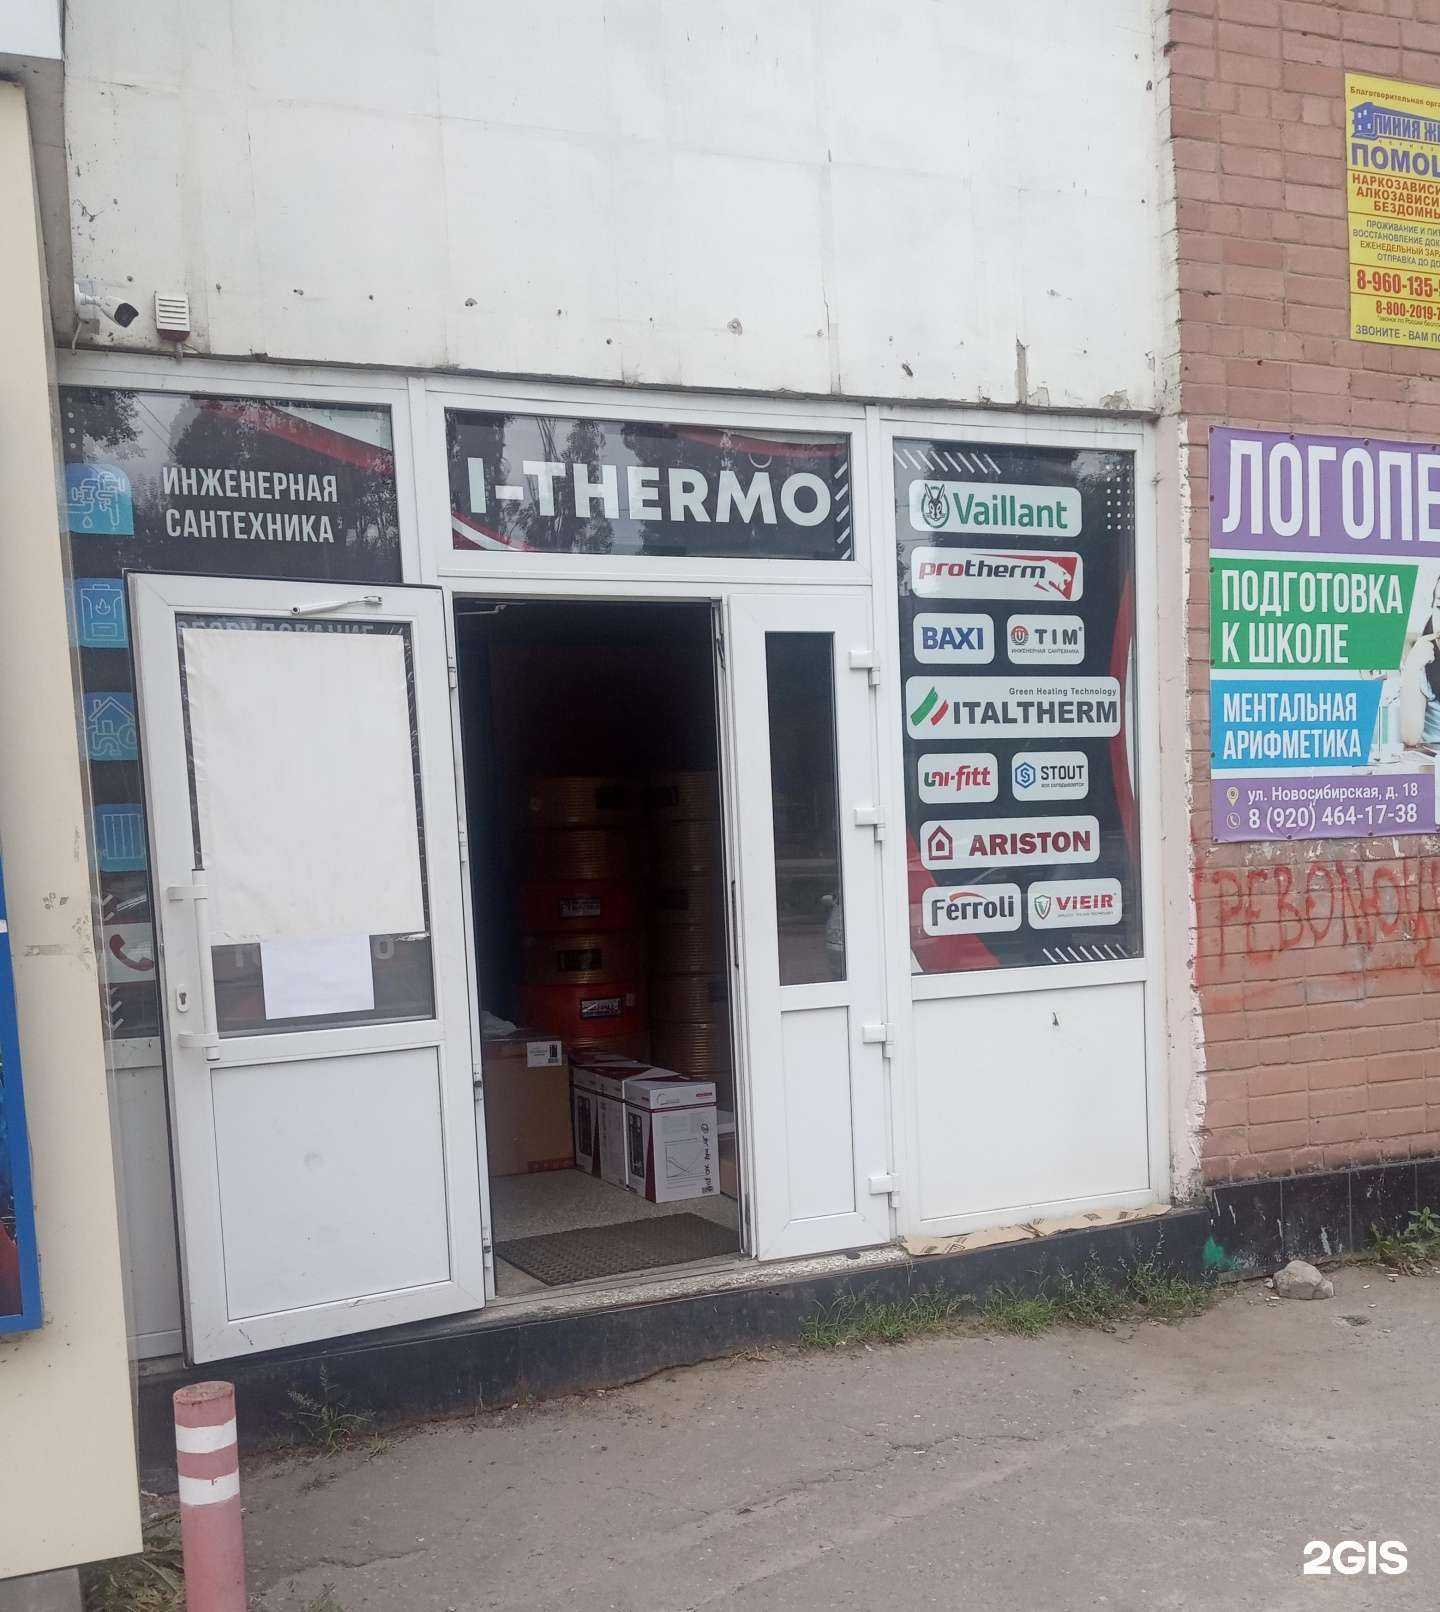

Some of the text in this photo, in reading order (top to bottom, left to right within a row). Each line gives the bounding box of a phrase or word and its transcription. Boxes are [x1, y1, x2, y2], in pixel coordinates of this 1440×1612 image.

[1350, 86, 1424, 105] Благотворительная
[1373, 113, 1421, 140] ЛИНИЯ
[1356, 186, 1440, 208] АЛКОЗАВИСИ
[1352, 228, 1423, 245] ВОССТАНОВЛЕНИЕ
[1366, 219, 1419, 234] ПРОЖИВАНИЕ
[1360, 240, 1424, 256] ЕЖЕНЕДЕЛЬНЫЙ
[1376, 253, 1416, 265] ОТПРАВКА
[1418, 258, 1429, 267] ДО
[1357, 269, 1440, 298] 8-960-135-
[1355, 325, 1401, 339] ЗВОНИТЕ
[1408, 330, 1429, 342] ВАМ
[162, 466, 338, 503] ИНЖЕНЕРНАЯ
[467, 457, 831, 527] I-THERMO
[1222, 439, 1440, 542] ЛОГОПЕ
[952, 492, 1068, 529] Vaillant
[165, 508, 334, 543] САНТЕХНИКА
[918, 559, 1046, 580] protherm
[1221, 569, 1403, 616] ПОДГОТОВКА
[921, 626, 984, 650] BAXI
[1034, 628, 1078, 645] TIM
[1222, 621, 1349, 664] К ШКОЛЕ
[1009, 687, 1117, 697] Green Heating Technology
[953, 700, 1117, 725] ITALTHERM
[1223, 692, 1357, 723] МЕНТАЛЬНАЯ
[1223, 728, 1362, 761] АРИФМЕТИКА
[923, 765, 991, 791] uni-fitt
[1040, 765, 1085, 780] STOUT
[1247, 782, 1418, 805] ул. Новосибирская, д. 18
[1249, 803, 1418, 833] 8 (920) 464-17-38
[969, 830, 1091, 857] ARISTON
[931, 895, 1015, 927] Ferroli
